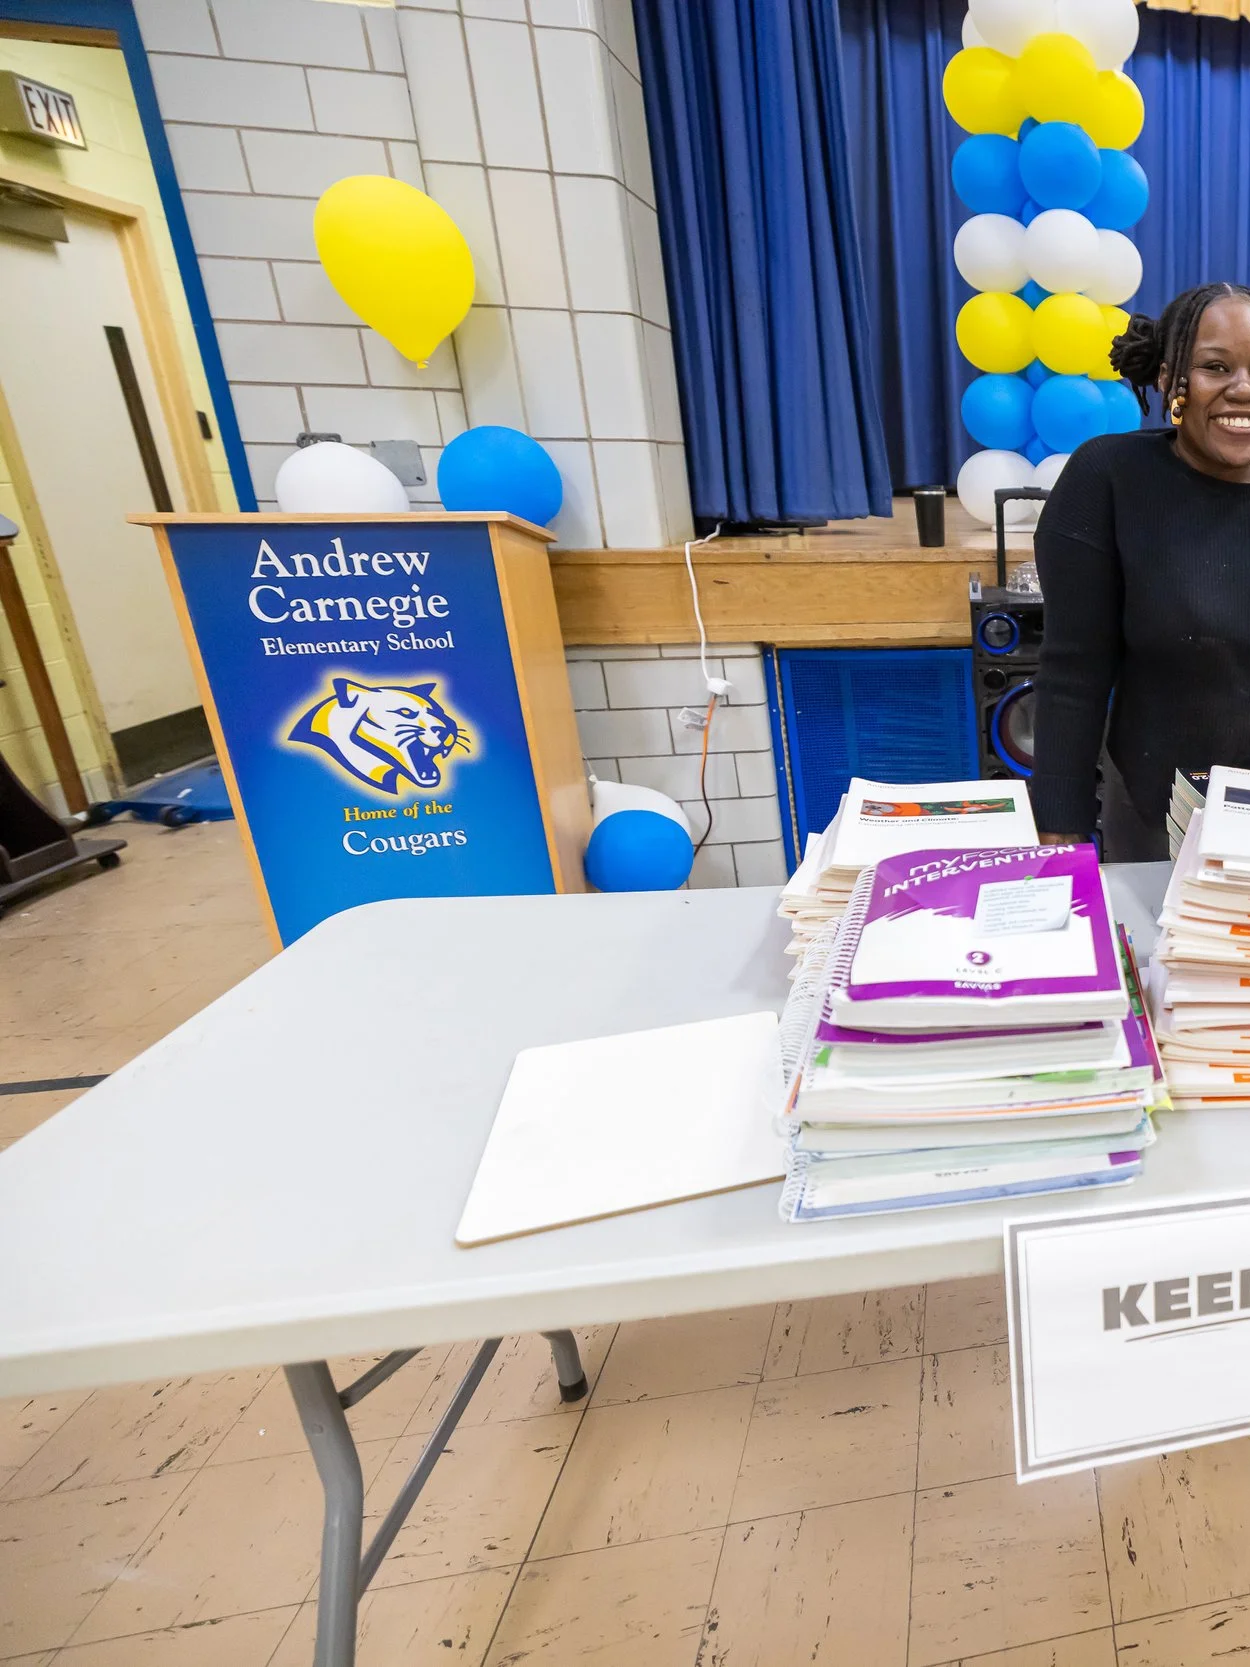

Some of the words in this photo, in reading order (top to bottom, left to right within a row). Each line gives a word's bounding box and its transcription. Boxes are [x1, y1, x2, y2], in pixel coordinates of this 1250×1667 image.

[22, 84, 77, 139] EXIT
[250, 537, 430, 579] Andrew
[248, 583, 450, 628] Carnegie
[260, 637, 381, 656] Elementary
[386, 631, 455, 651] School
[343, 807, 397, 822] Home
[403, 802, 419, 818] of
[424, 801, 453, 816] the
[342, 828, 467, 857] Cougars
[883, 844, 1076, 898] INTERVENTION
[971, 952, 985, 964] 2
